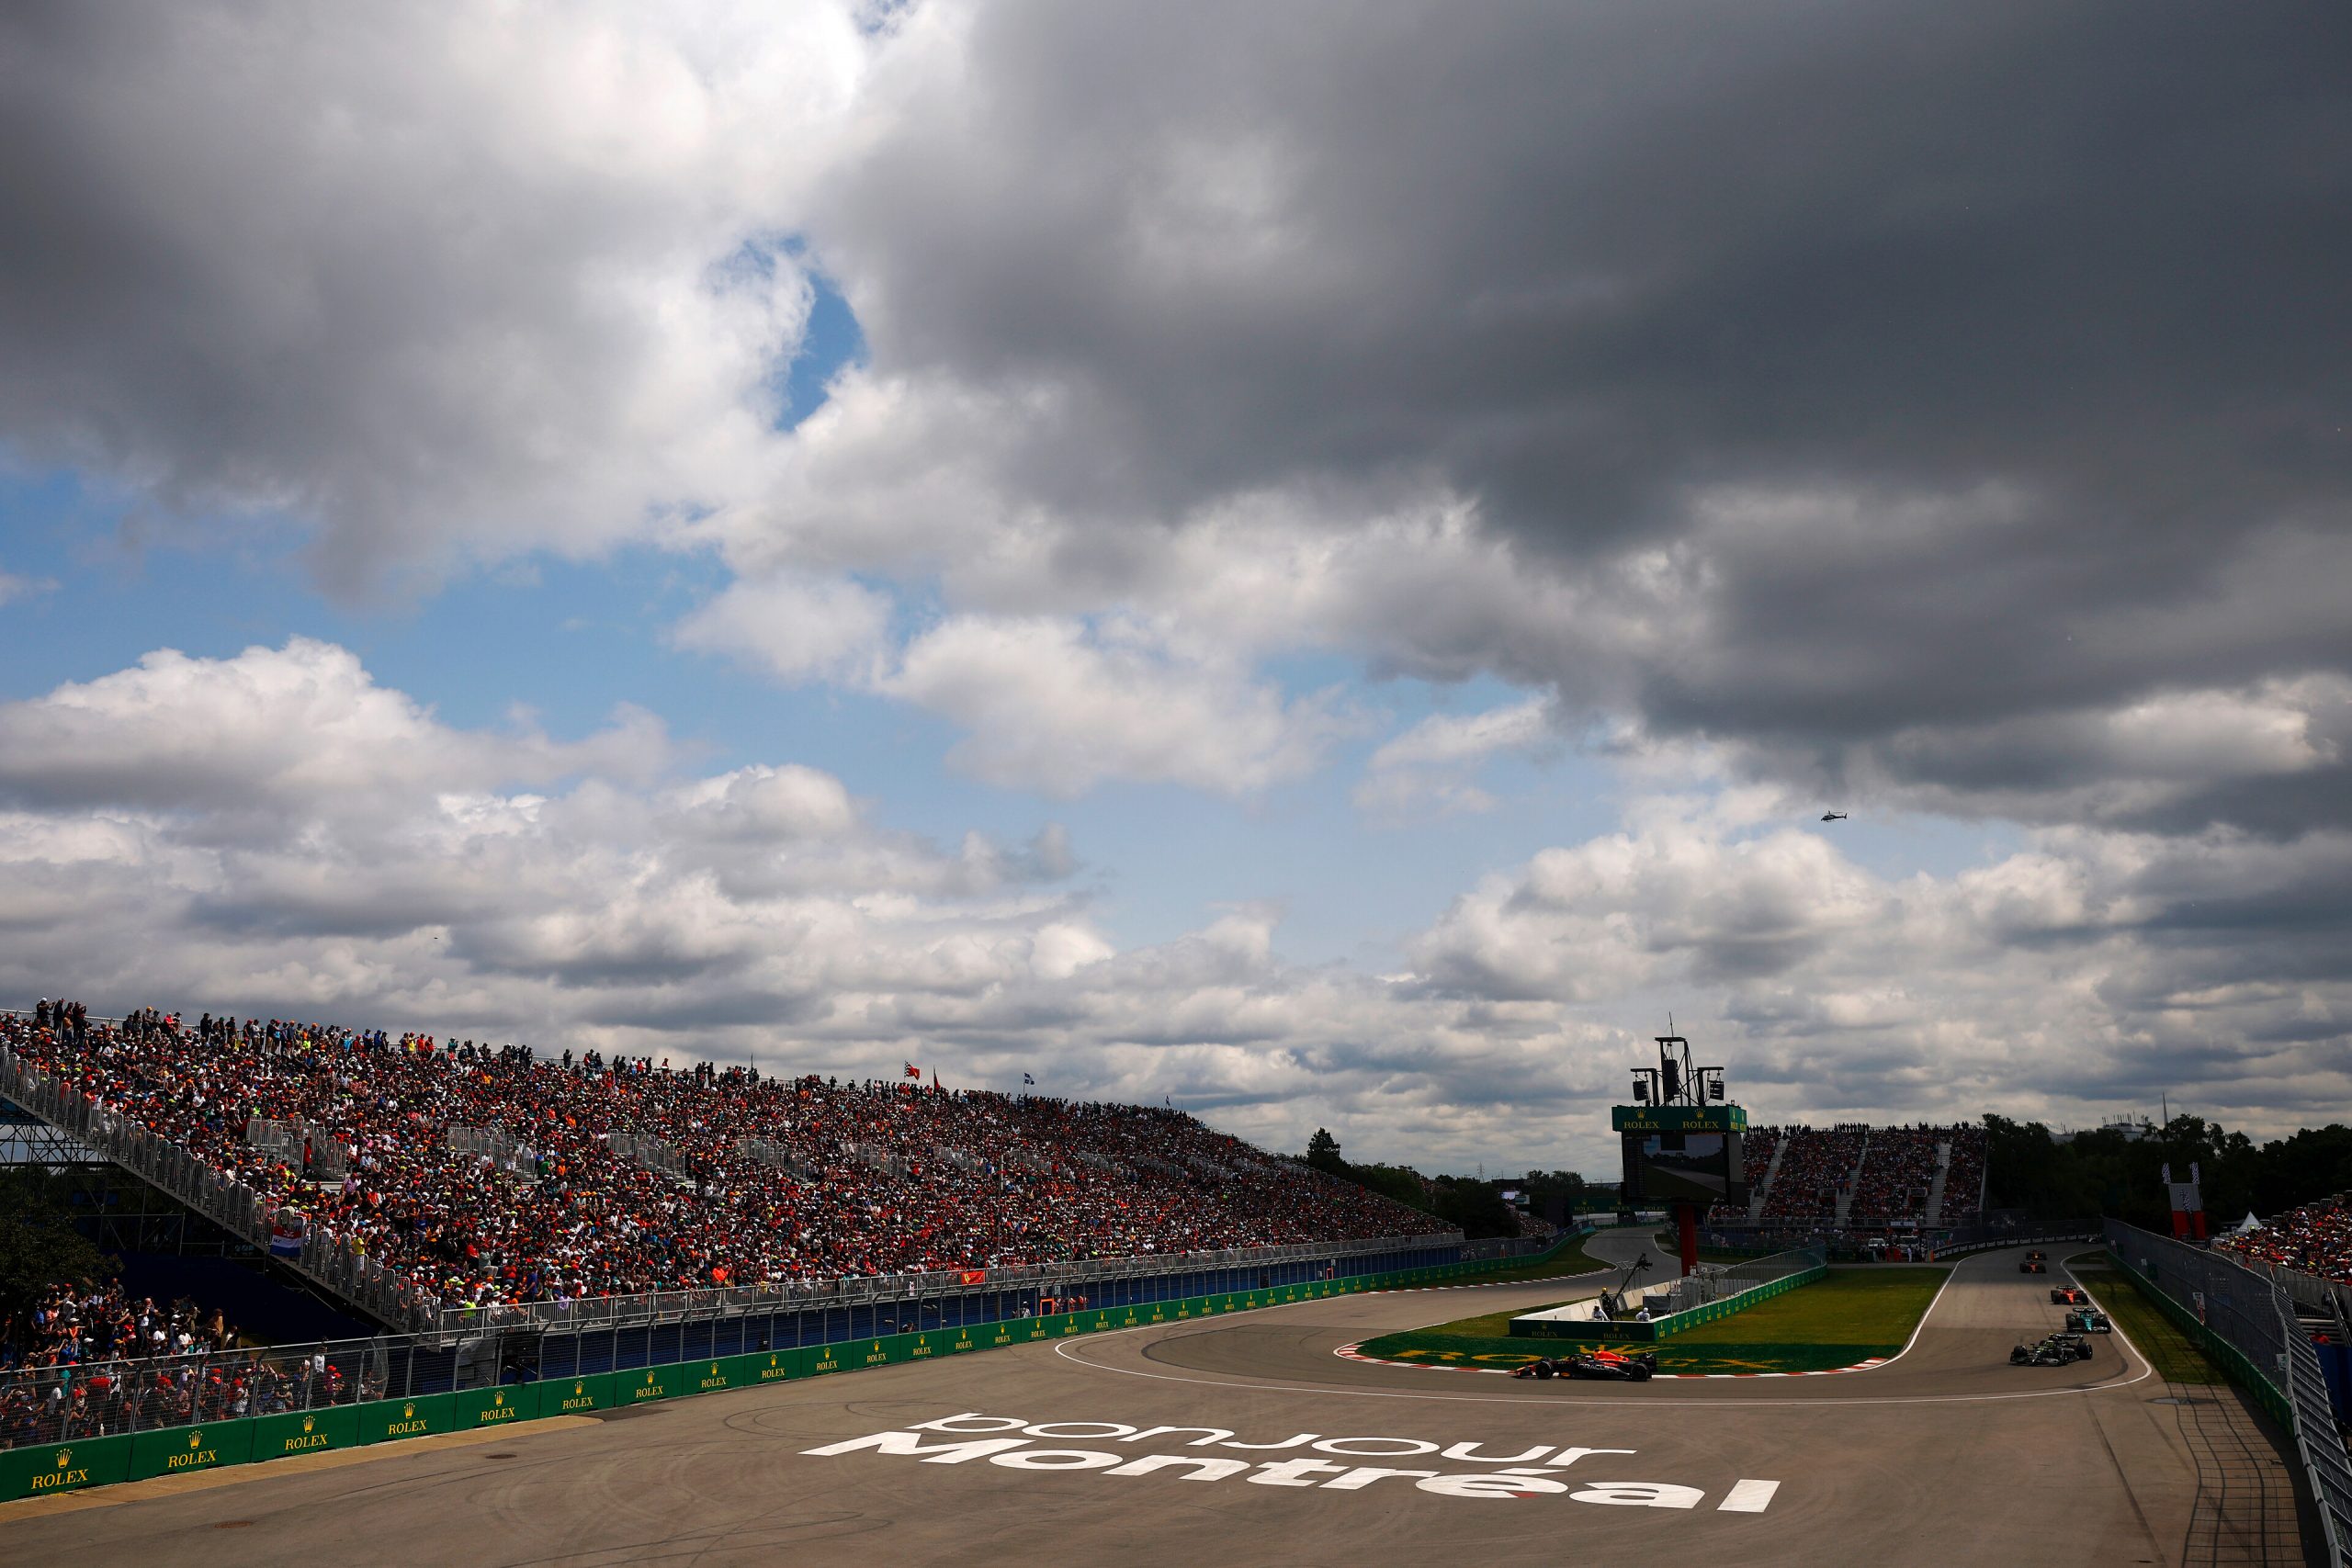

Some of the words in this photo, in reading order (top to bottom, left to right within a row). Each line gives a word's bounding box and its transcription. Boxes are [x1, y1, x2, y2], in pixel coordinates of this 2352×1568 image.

[1623, 1121, 1660, 1130] ROLEX
[1682, 1121, 1719, 1130] ROLEX
[1031, 1329, 1046, 1338] ROLEX
[1064, 1325, 1079, 1334] ROLEX
[956, 1340, 973, 1349] ROLEX
[995, 1335, 1011, 1344] ROLEX
[913, 1346, 932, 1356] ROLEX
[866, 1353, 887, 1363] ROLEX
[817, 1360, 838, 1371] ROLEX
[762, 1368, 785, 1379] ROLEX
[701, 1376, 727, 1389] ROLEX
[636, 1385, 663, 1398] ROLEX
[562, 1396, 594, 1409] ROLEX
[481, 1407, 515, 1421] ROLEX
[388, 1419, 427, 1435] ROLEX
[285, 1433, 328, 1450] ROLEX
[168, 1449, 218, 1468] ROLEX
[797, 1430, 1781, 1514] Montréal
[31, 1469, 88, 1489] ROLEX
